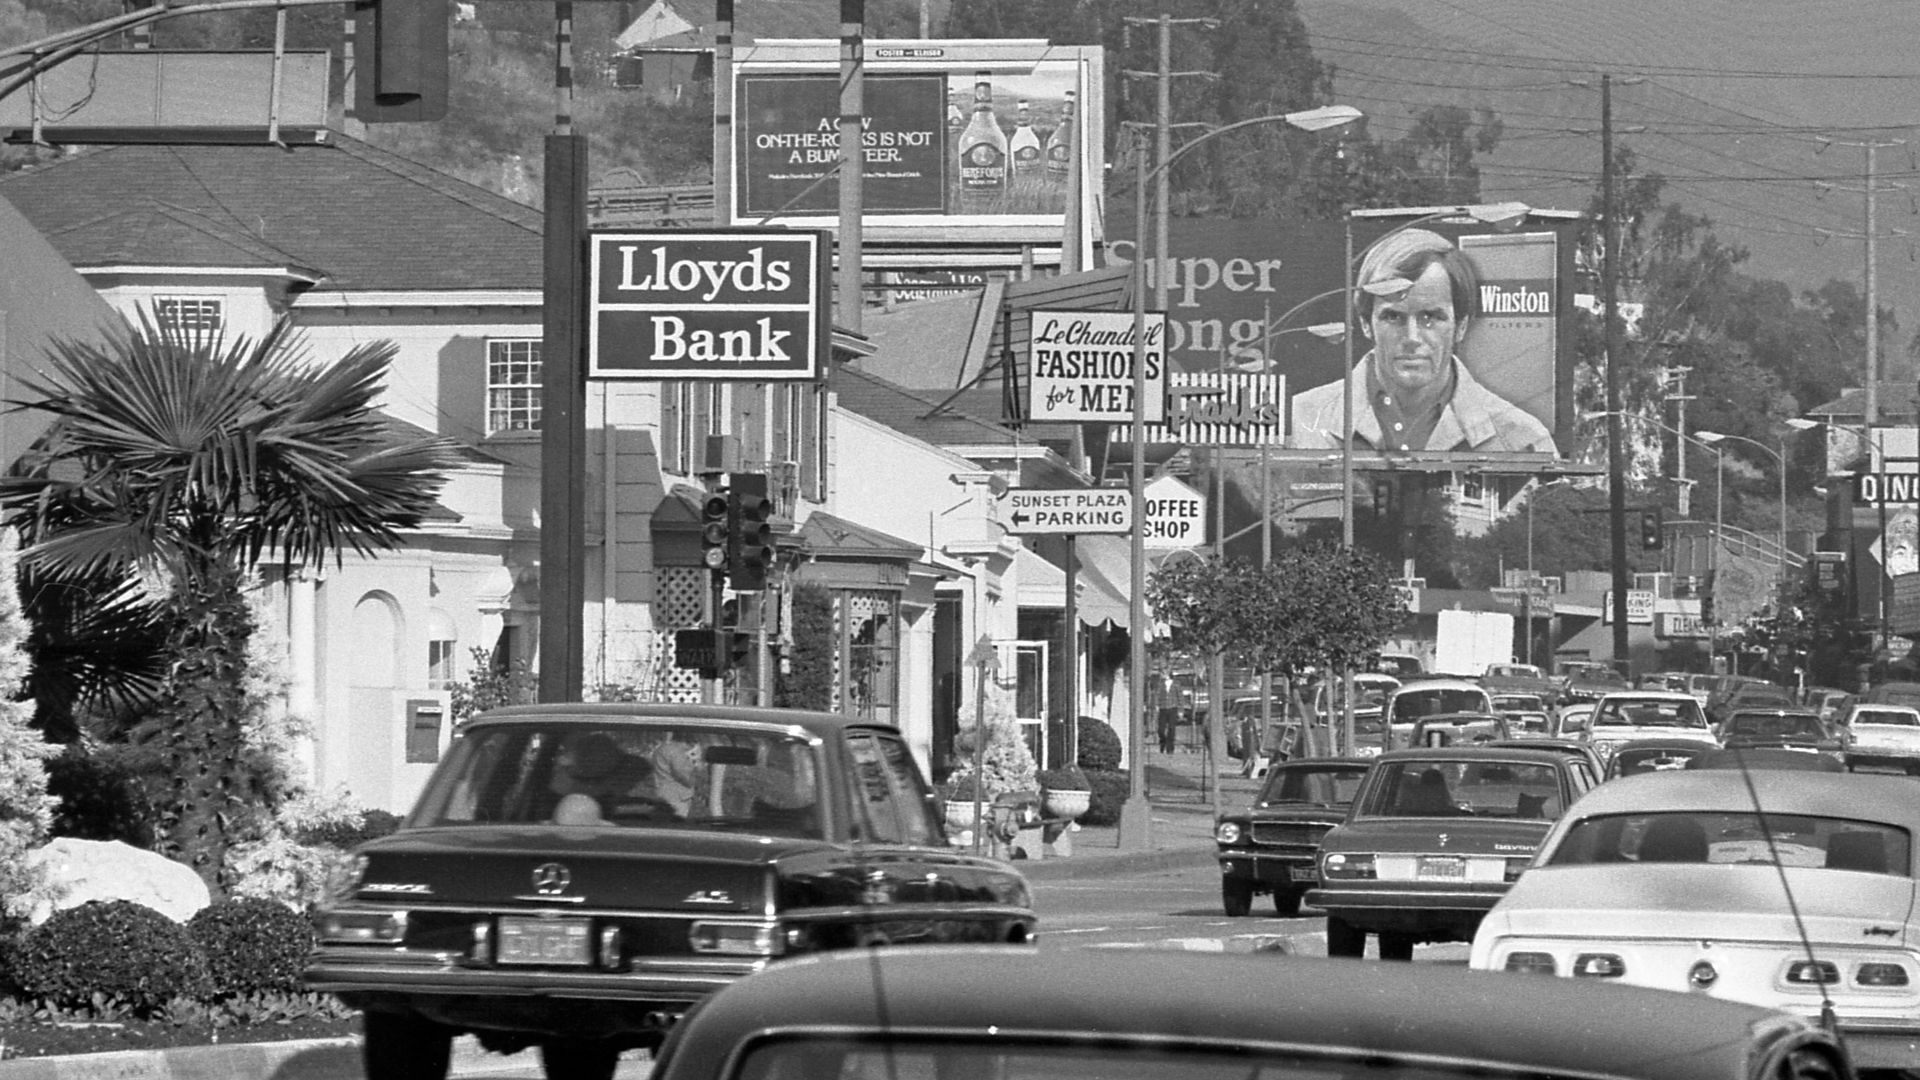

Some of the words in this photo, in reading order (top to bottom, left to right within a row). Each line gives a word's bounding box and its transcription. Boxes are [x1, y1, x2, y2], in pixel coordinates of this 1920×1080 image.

[818, 118, 831, 131] A
[833, 117, 872, 130] CW
[880, 132, 894, 146] IS
[898, 132, 933, 146] NOT
[789, 151, 802, 163] A
[862, 148, 902, 162] EER.
[618, 246, 791, 301] Lloyds
[1104, 240, 1283, 308] Super
[1480, 285, 1550, 313] Winston
[650, 316, 791, 361] Bank
[1065, 320, 1164, 346] Chandil
[1168, 318, 1266, 370] ong
[1046, 384, 1076, 412] for
[1168, 385, 1280, 435] Frank's
[1011, 495, 1071, 508] SUNSET
[1076, 494, 1127, 508] PLAZA
[1146, 500, 1199, 518] OFFEE
[1035, 510, 1125, 526] PARKING
[1143, 520, 1191, 539] SHOP
